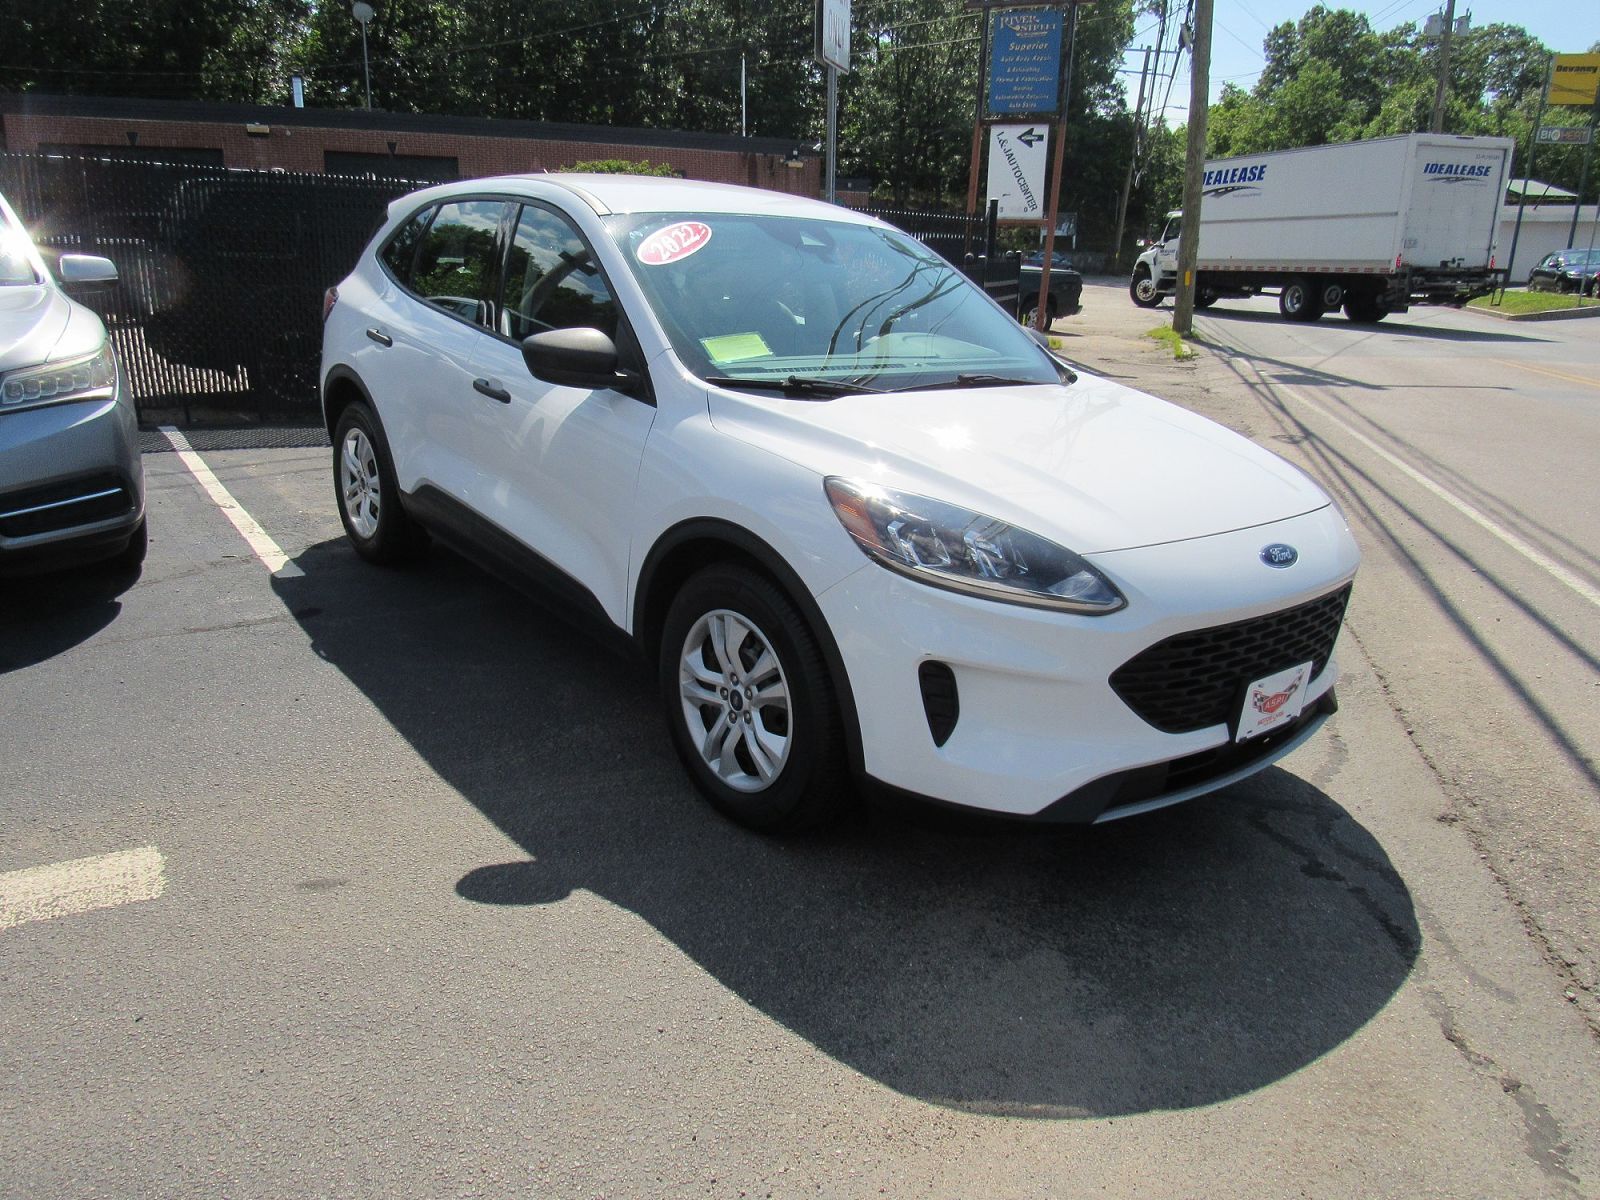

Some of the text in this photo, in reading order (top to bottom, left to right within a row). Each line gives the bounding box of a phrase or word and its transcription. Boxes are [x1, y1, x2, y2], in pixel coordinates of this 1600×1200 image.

[1000, 15, 1040, 29] RIVER
[1008, 41, 1048, 51] Superior
[1423, 163, 1492, 177] IDEALEASE
[650, 225, 702, 261] 2022
[1270, 547, 1292, 562] Ford
